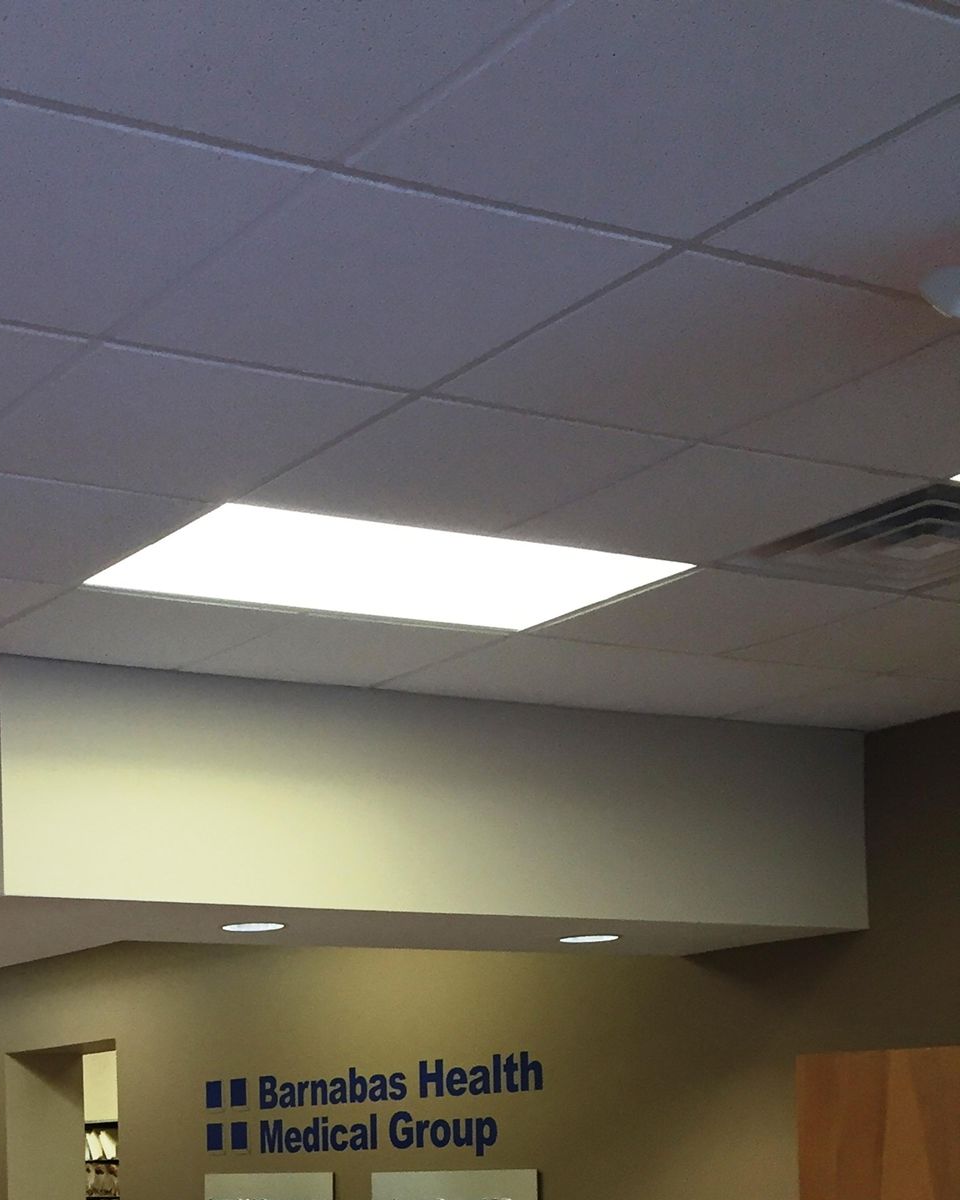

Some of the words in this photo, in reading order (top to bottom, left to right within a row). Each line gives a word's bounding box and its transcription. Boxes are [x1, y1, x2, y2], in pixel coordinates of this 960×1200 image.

[259, 1067, 407, 1109] Barnabas
[419, 1051, 543, 1098] Health
[260, 1113, 377, 1154] Medical
[389, 1111, 498, 1156] Group
